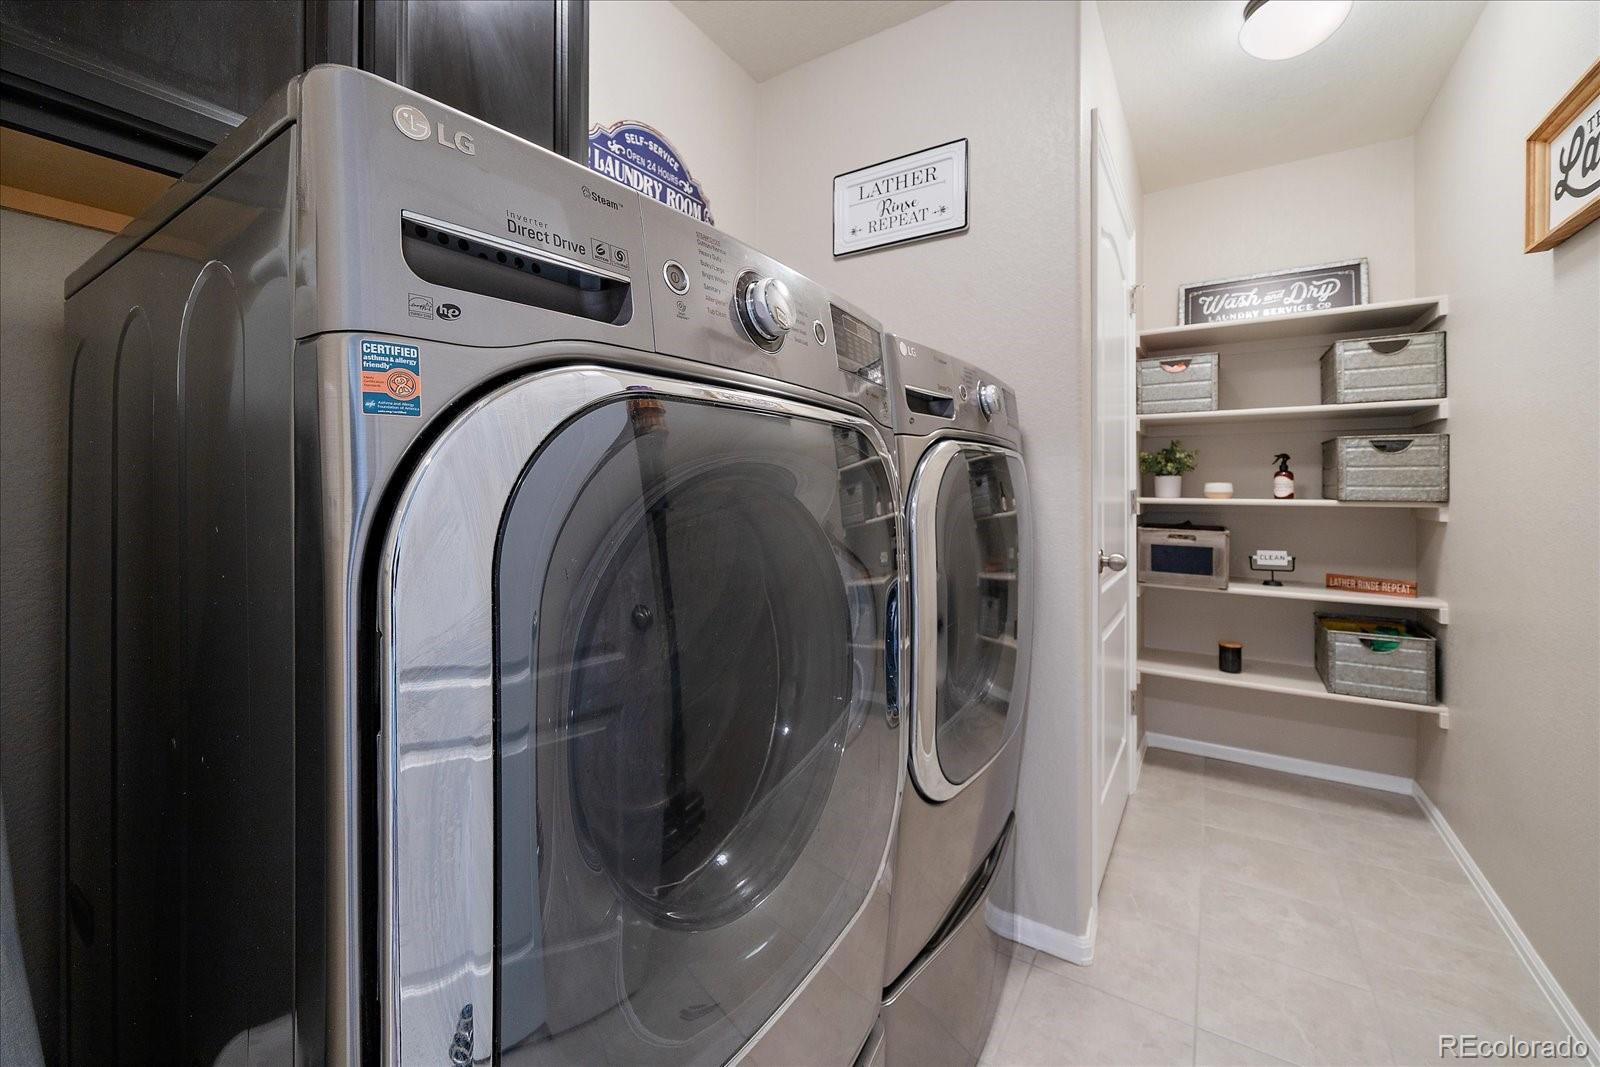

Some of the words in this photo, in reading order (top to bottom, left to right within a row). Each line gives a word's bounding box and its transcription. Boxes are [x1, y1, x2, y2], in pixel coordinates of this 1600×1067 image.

[437, 121, 476, 156] LG
[624, 132, 680, 172] SELF-SERVICE
[646, 160, 657, 173] 24
[594, 148, 664, 202] LAUNDRY
[665, 187, 702, 221] ROOM
[859, 166, 938, 201] LATHER
[878, 197, 918, 218] Rinse
[505, 209, 549, 229] Inverter
[868, 207, 929, 234] REPEAT
[507, 219, 550, 245] Direct
[553, 233, 586, 256] Drive
[1198, 287, 1262, 315] Wash
[1263, 291, 1285, 302] and
[1283, 278, 1341, 305] Dry
[1208, 310, 1260, 322] LAUNDRY
[1263, 303, 1313, 316] SERVICE
[362, 342, 418, 358] CERTIFIED
[362, 354, 389, 363] asthma
[395, 358, 417, 366] allergy
[907, 346, 917, 357] LG
[1259, 553, 1286, 562] CLEAN
[1329, 576, 1356, 589] LATHER
[1357, 579, 1381, 592] RINSE
[1381, 581, 1411, 594] REPEAT
